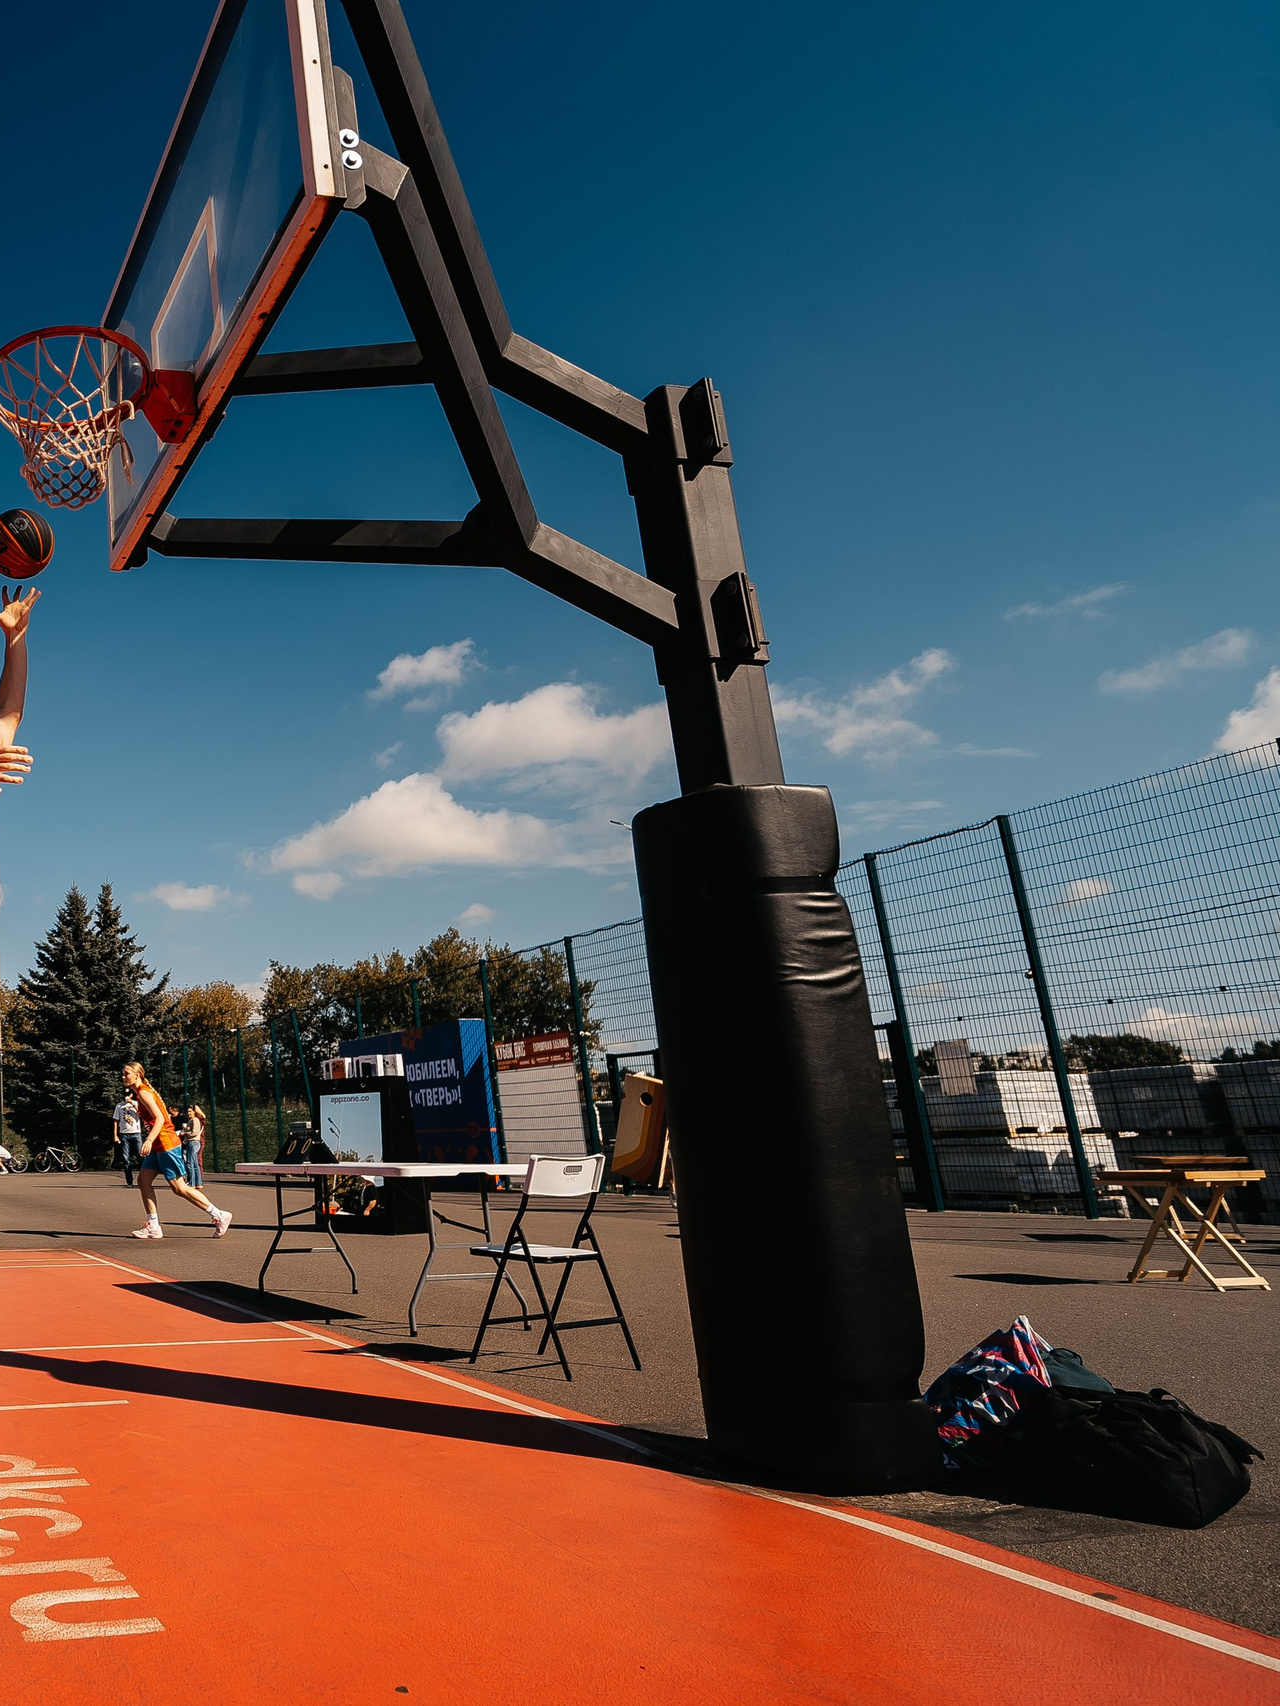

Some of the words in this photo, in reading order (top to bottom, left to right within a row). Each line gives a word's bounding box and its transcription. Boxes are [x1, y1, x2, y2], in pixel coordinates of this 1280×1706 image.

[405, 1058, 460, 1082] ЮБИЛЕЕМ,
[330, 1095, 370, 1105] appzone.co
[414, 1085, 462, 1107] «ТВЕРЬ»!
